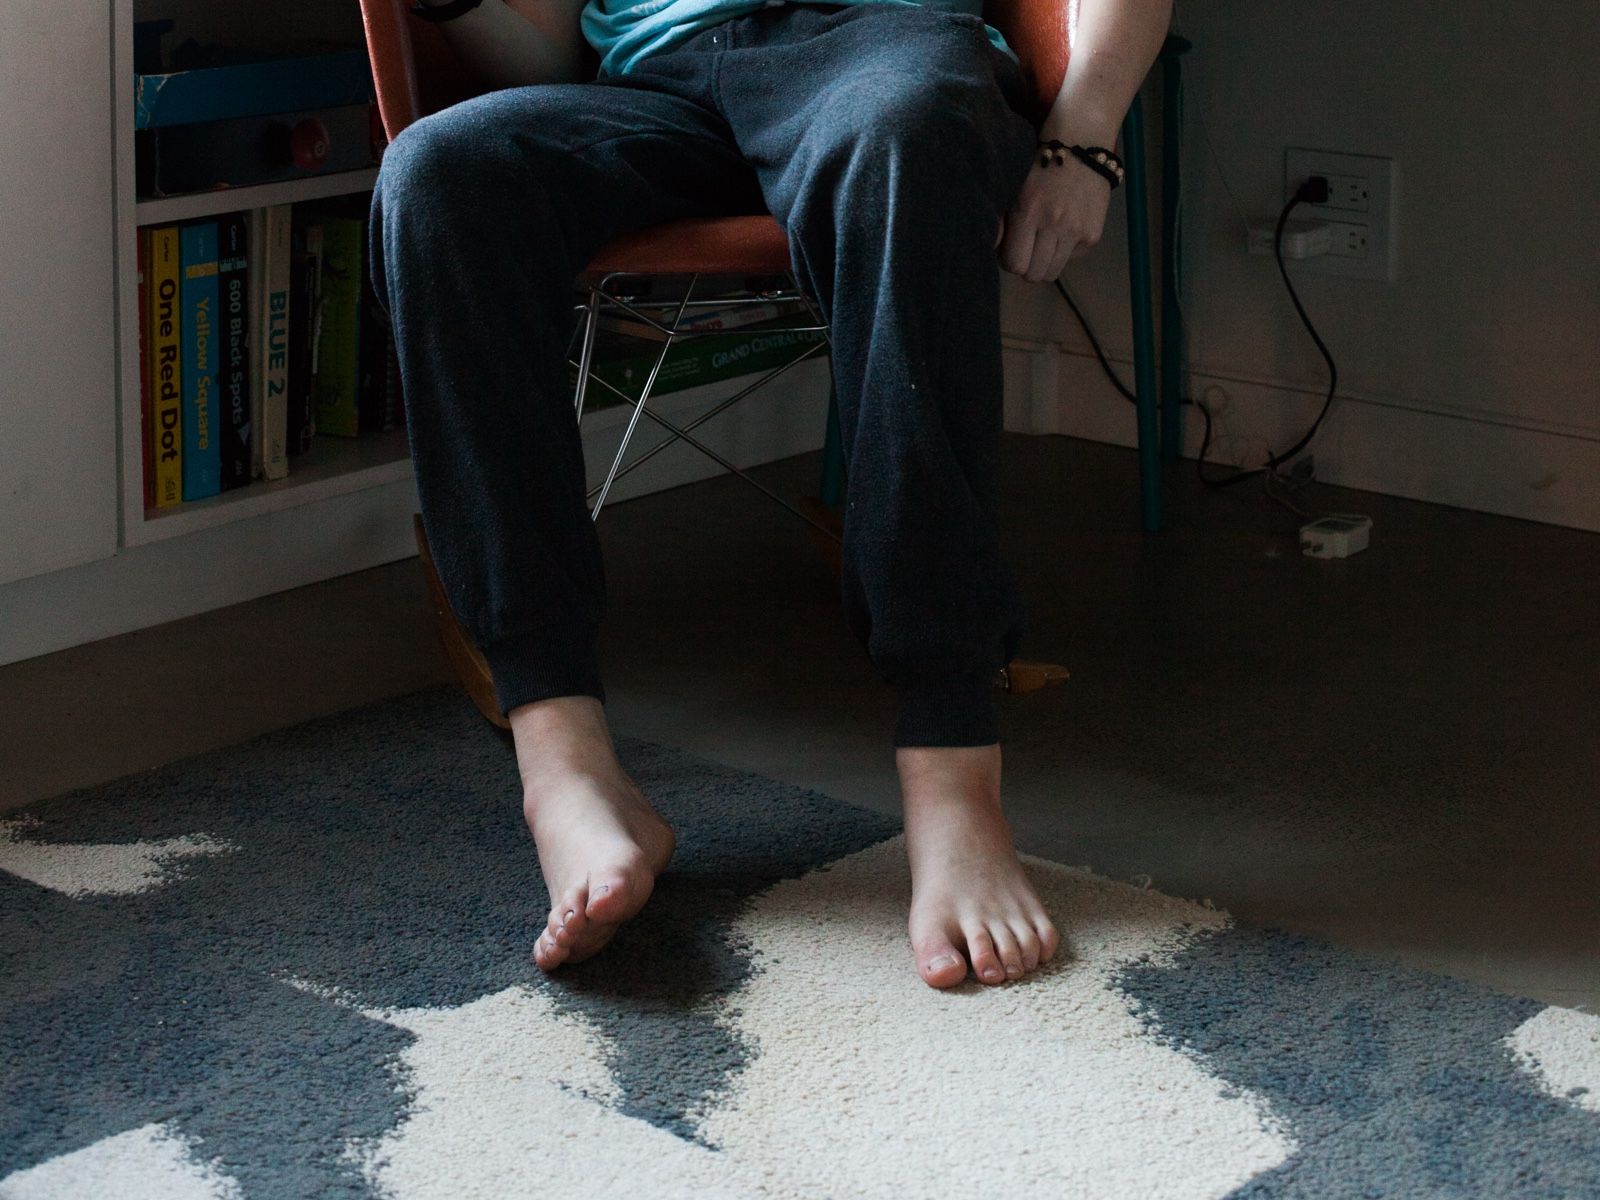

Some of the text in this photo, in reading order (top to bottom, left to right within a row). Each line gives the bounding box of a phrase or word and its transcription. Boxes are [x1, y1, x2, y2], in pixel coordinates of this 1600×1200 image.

[158, 278, 175, 337] One
[228, 279, 241, 311] 600
[196, 297, 210, 371] Yellow
[229, 314, 243, 366] Black
[268, 291, 286, 397] BLUE 2
[711, 345, 751, 369] GRAND
[160, 343, 178, 401] Red
[231, 367, 243, 425] Spots
[160, 408, 178, 464] Dot
[196, 375, 211, 451] Square
